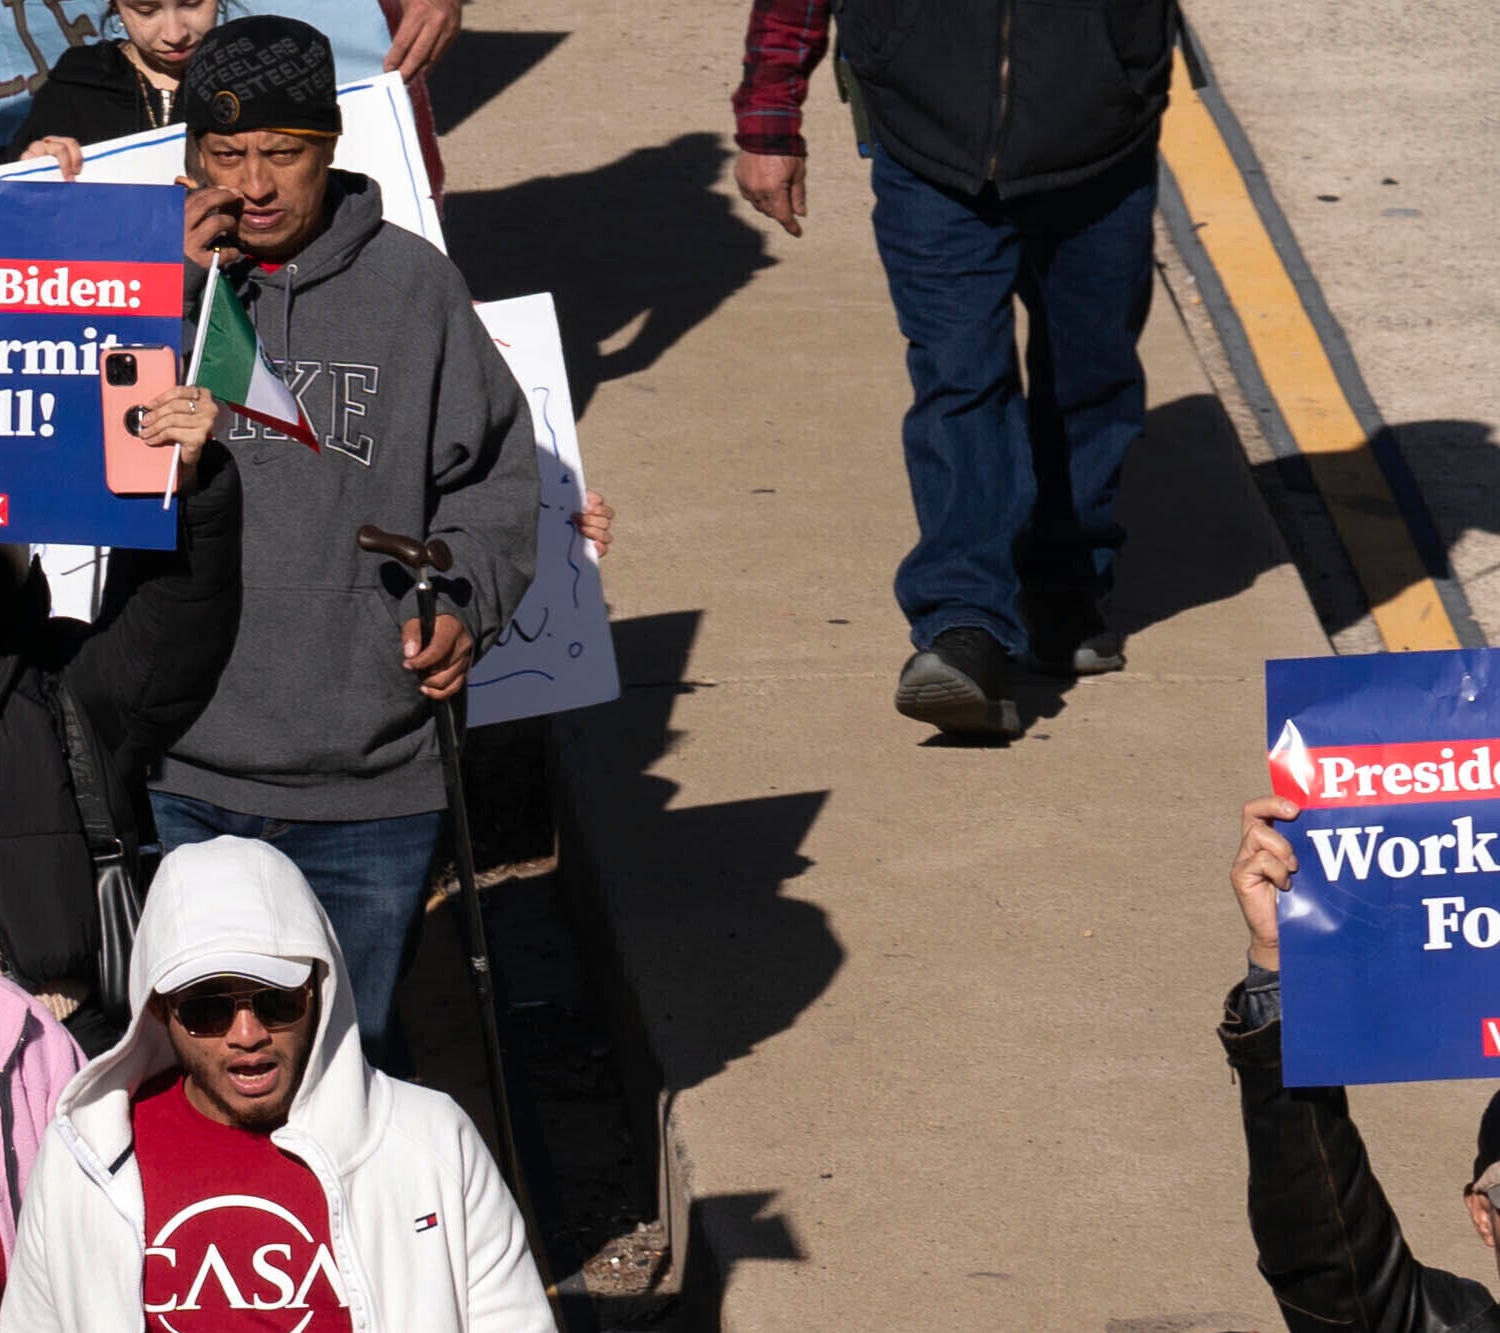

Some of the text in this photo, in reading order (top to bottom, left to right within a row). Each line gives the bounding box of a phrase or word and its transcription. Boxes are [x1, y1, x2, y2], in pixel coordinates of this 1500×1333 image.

[1318, 746, 1500, 799] Presid
[1305, 815, 1500, 882] Work
[1422, 896, 1500, 951] Fo
[144, 1240, 353, 1315] CASA
